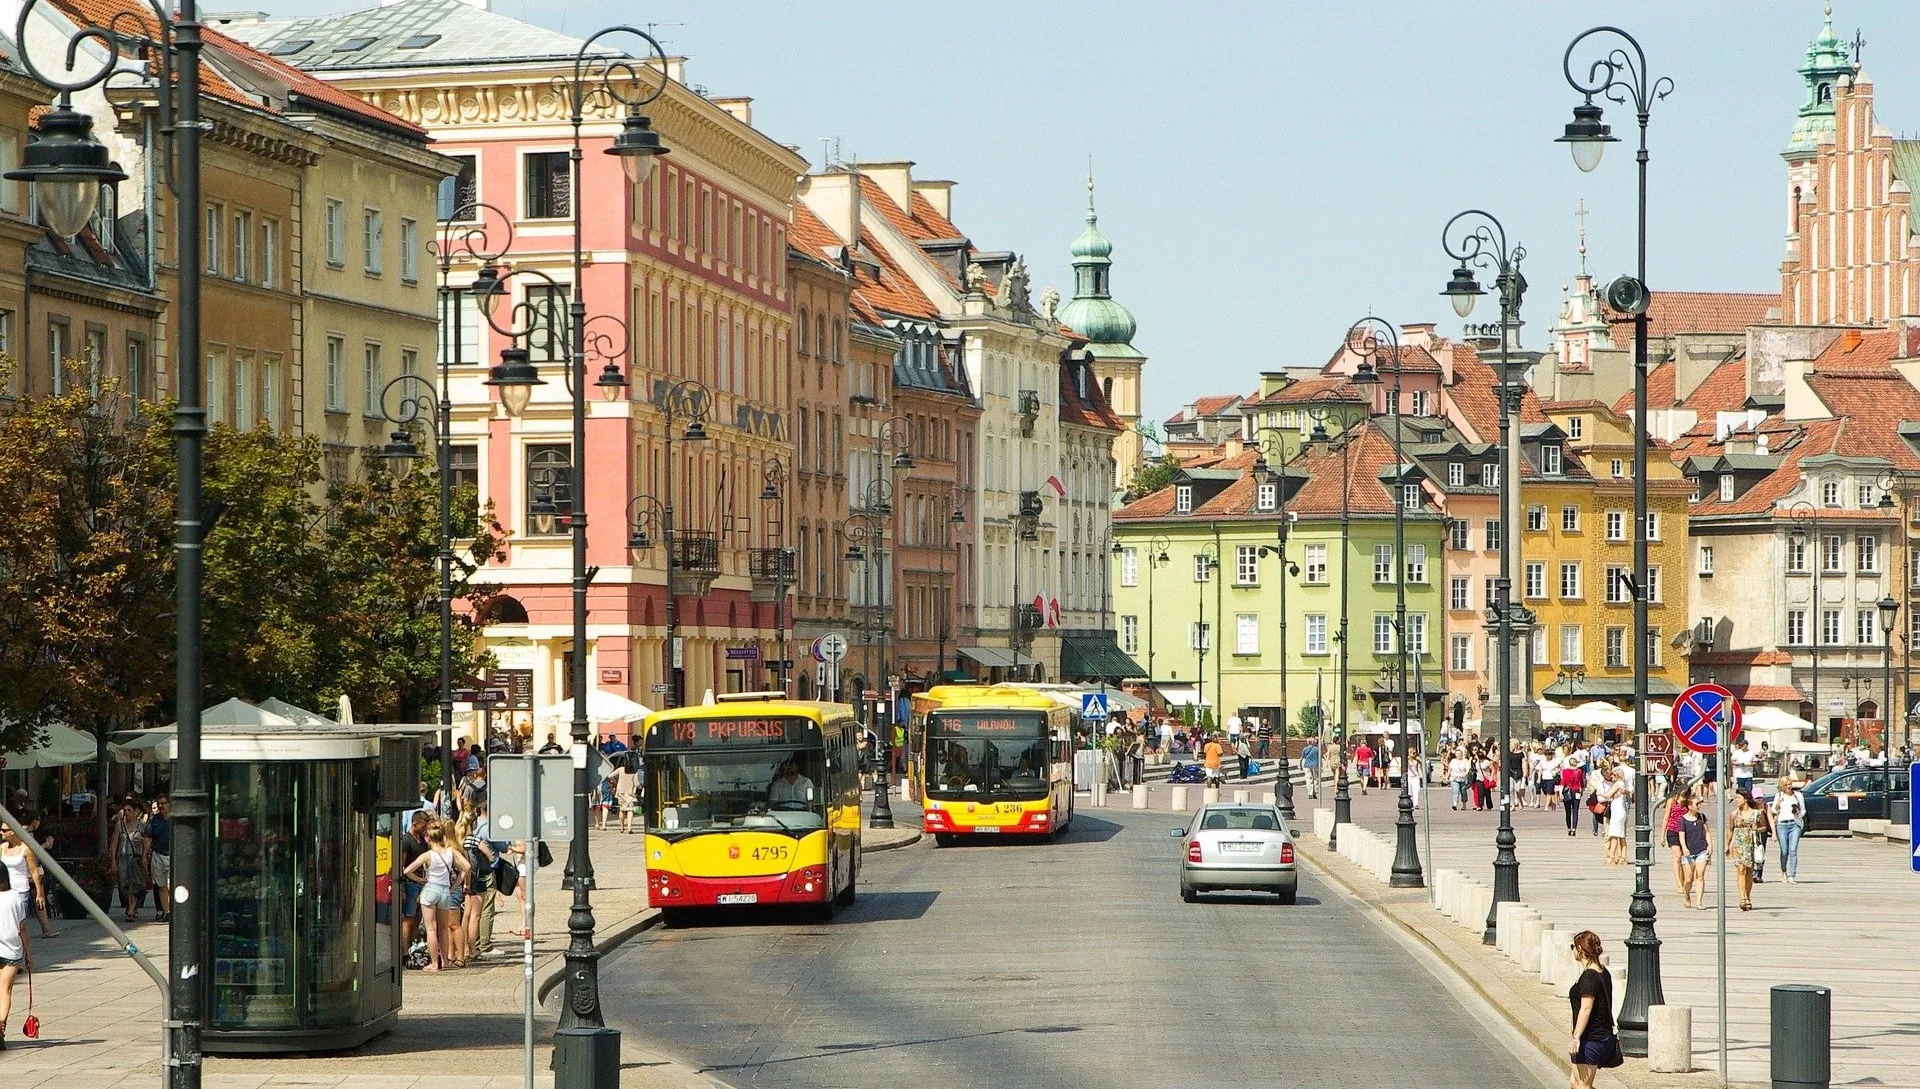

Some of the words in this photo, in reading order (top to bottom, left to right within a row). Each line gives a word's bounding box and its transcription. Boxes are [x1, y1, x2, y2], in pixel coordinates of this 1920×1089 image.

[672, 721, 696, 740] 178
[708, 721, 736, 737] PKP
[739, 720, 784, 737] URSUS
[942, 718, 961, 732] 116
[1647, 759, 1661, 771] WC
[1003, 804, 1022, 813] 236
[752, 846, 788, 861] 4795
